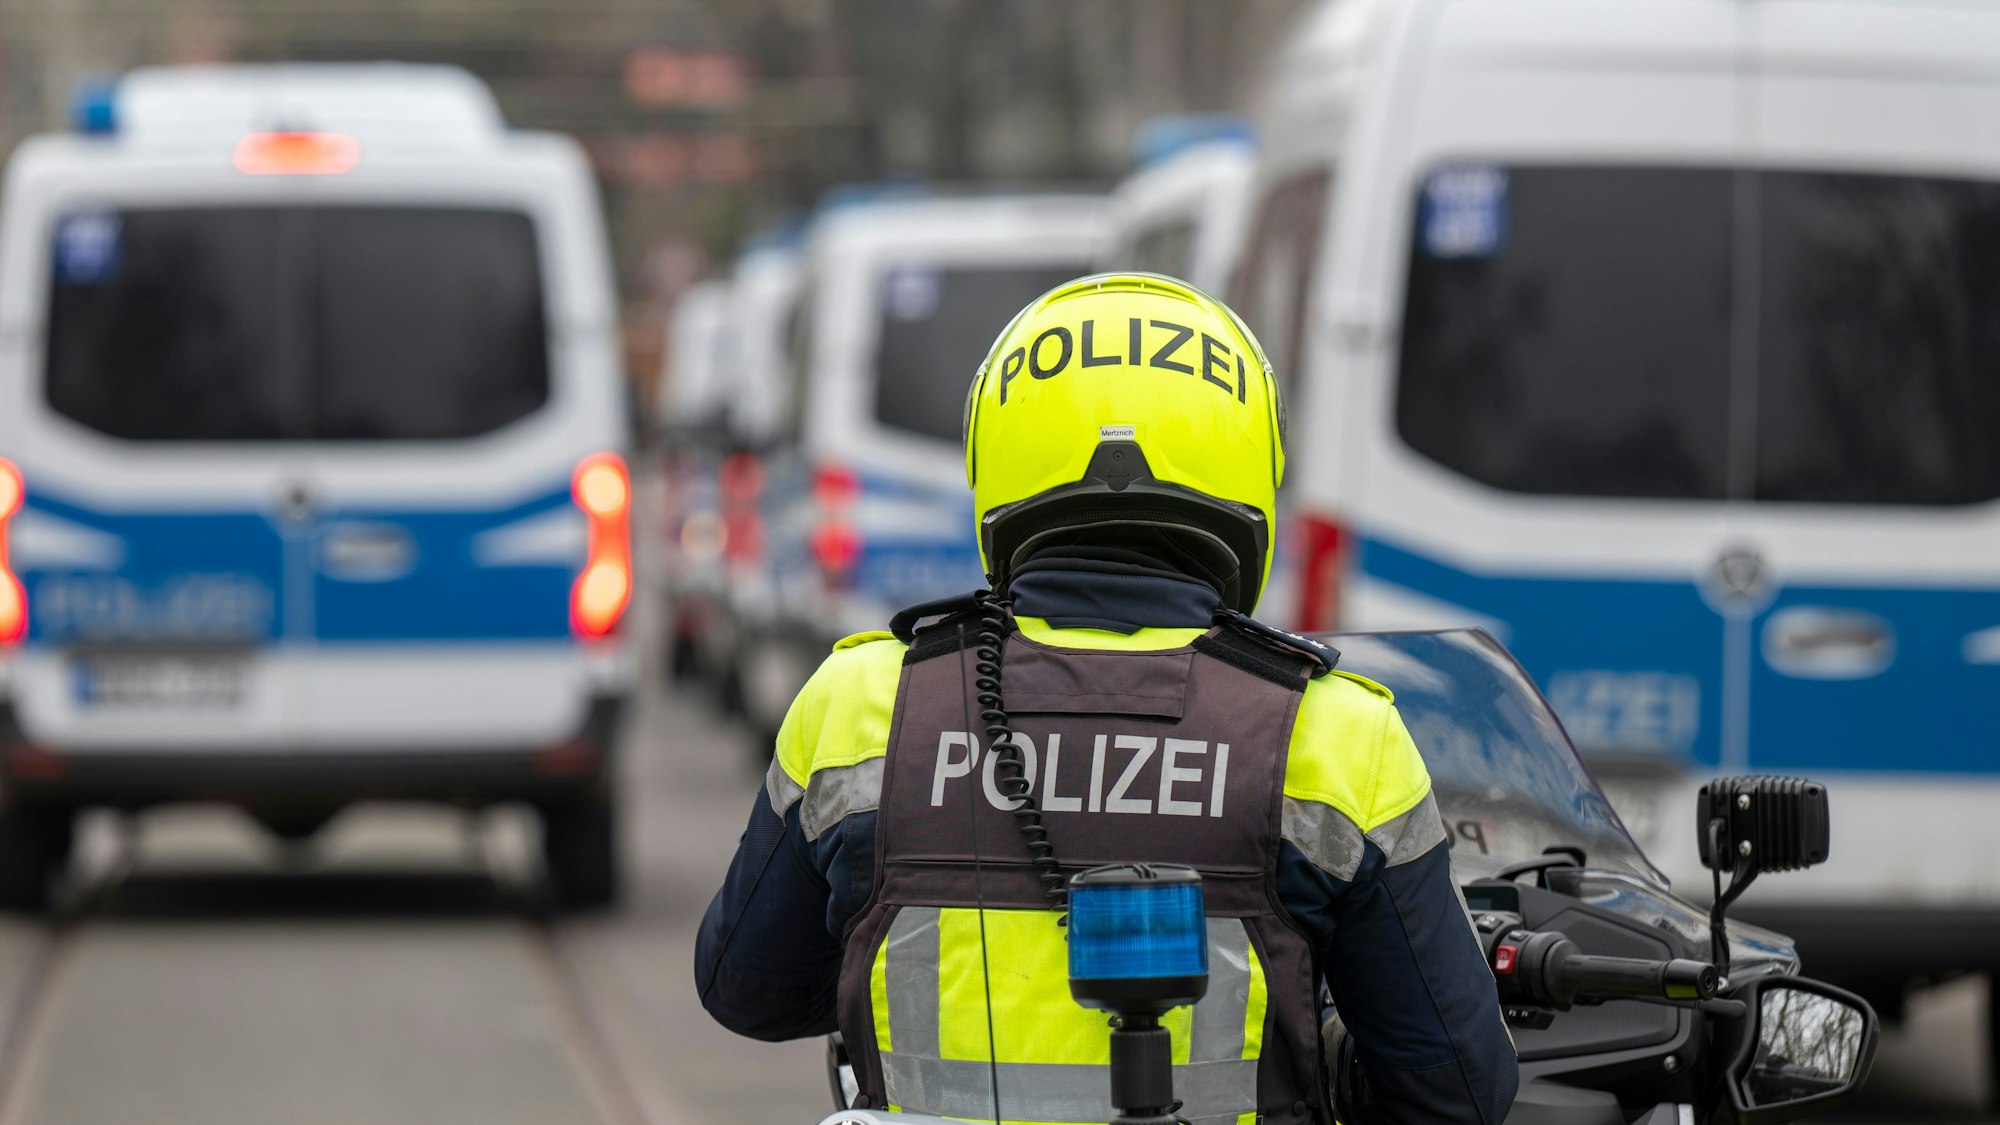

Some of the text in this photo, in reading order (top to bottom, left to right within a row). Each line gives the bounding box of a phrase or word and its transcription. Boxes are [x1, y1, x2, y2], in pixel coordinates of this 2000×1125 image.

[1000, 318, 1246, 406] POLIZEI
[1101, 429, 1134, 437] Mertznich
[930, 731, 1230, 817] POLIZEI
